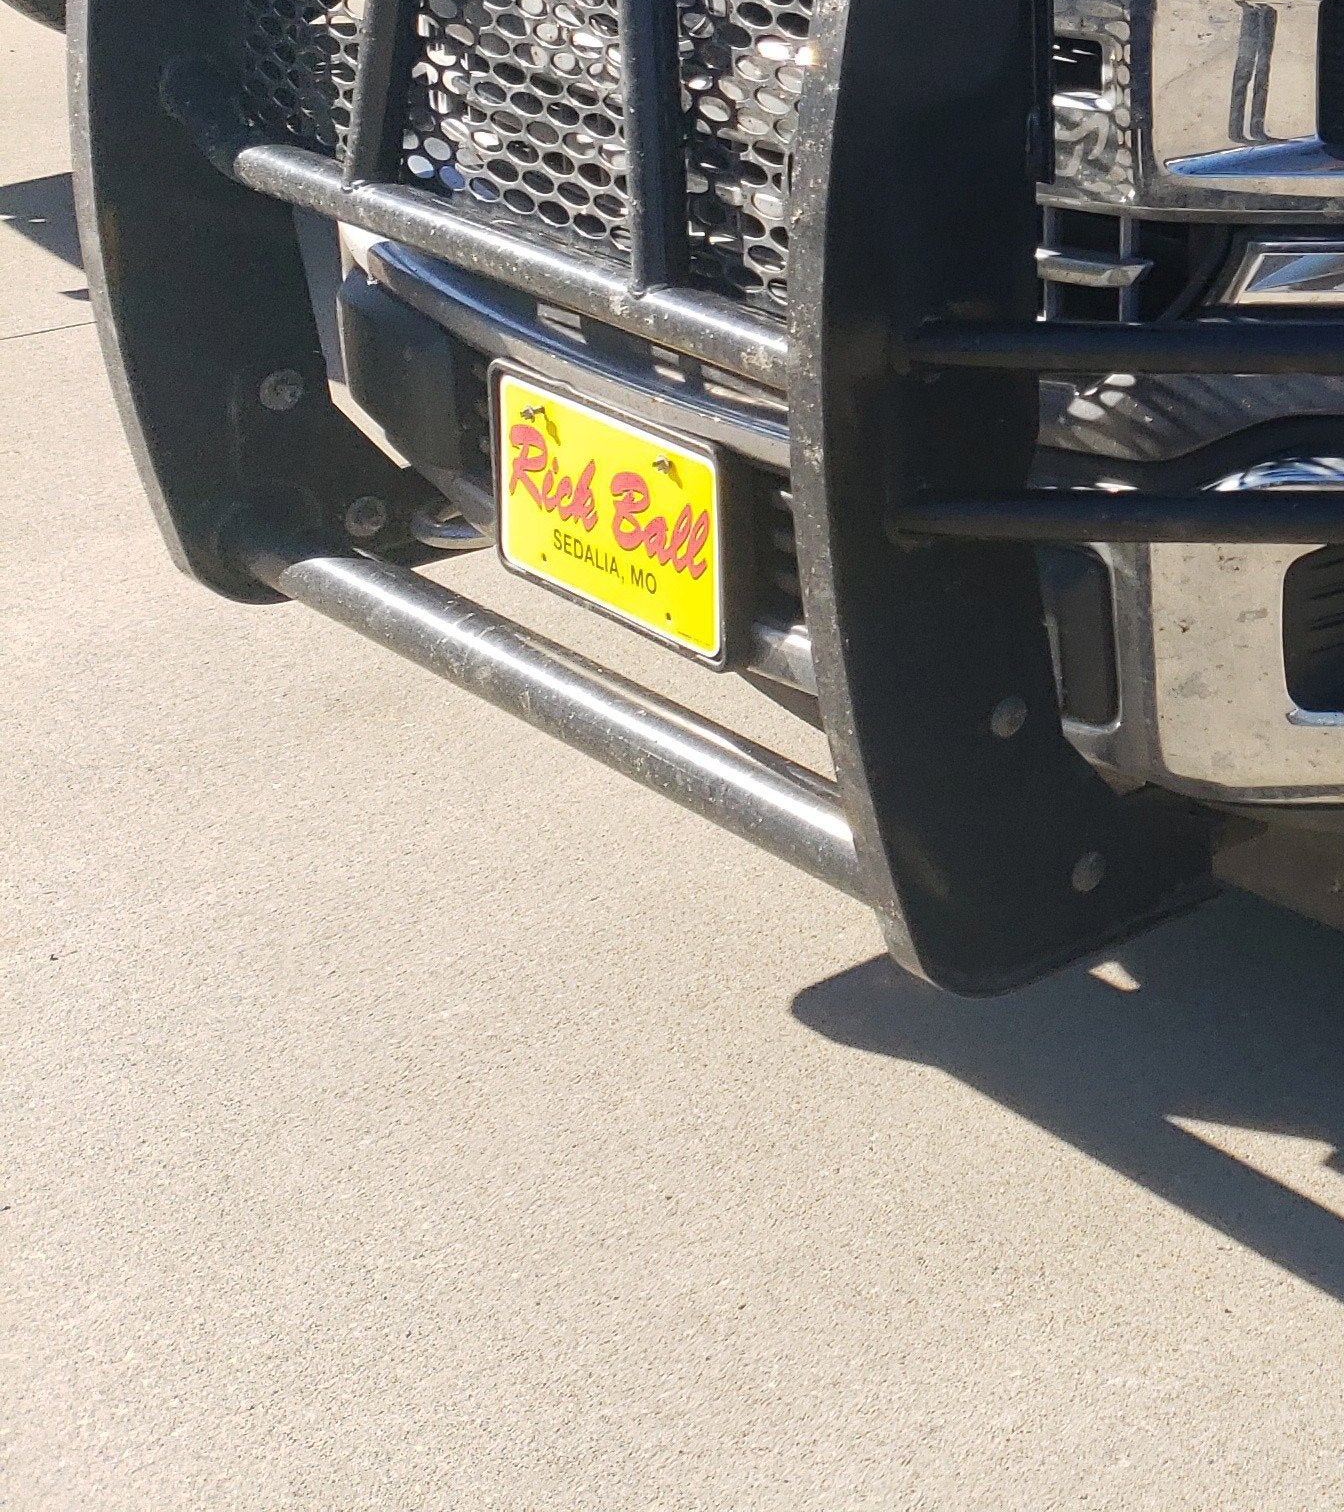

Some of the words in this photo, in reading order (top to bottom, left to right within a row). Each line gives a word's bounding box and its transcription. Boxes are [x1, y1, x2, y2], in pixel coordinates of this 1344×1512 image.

[509, 424, 598, 532] Rick
[610, 471, 710, 580] Ball
[553, 528, 625, 584] SEDALIA,
[630, 564, 657, 594] MO
